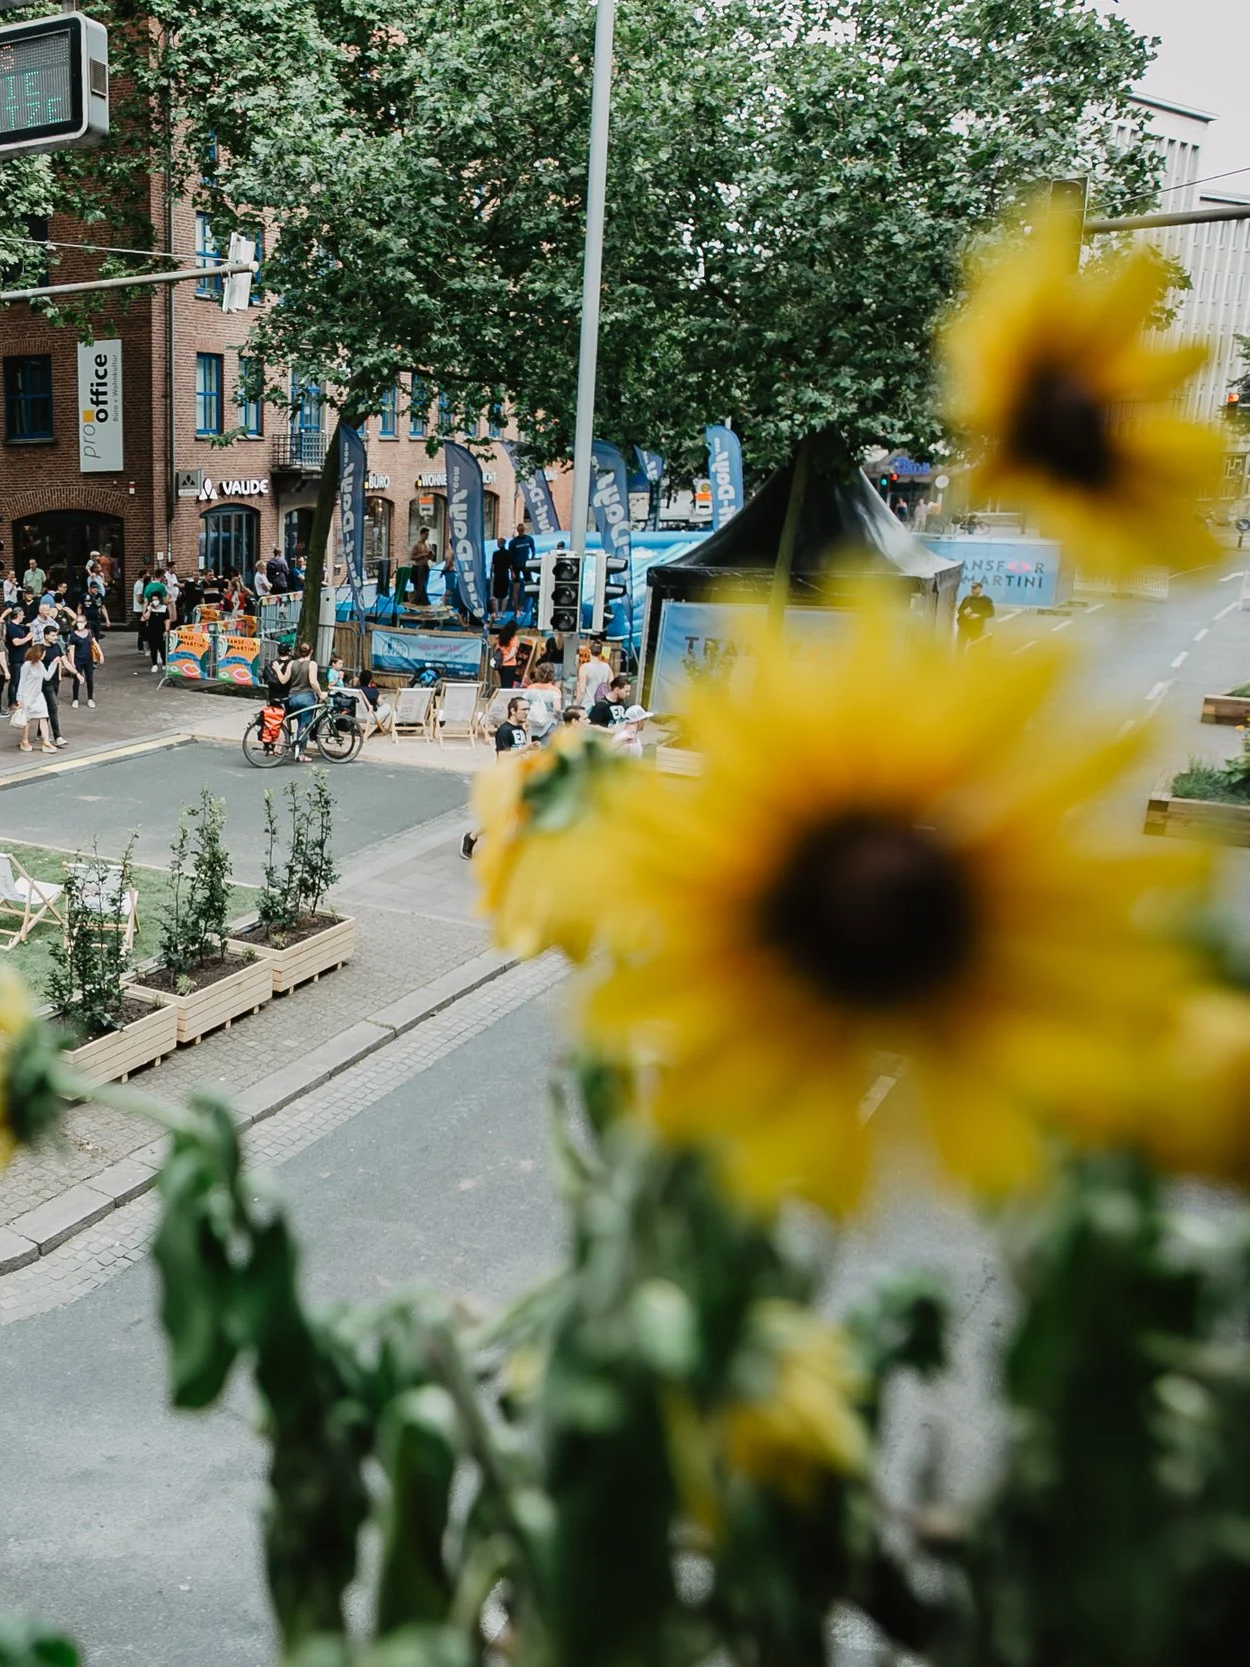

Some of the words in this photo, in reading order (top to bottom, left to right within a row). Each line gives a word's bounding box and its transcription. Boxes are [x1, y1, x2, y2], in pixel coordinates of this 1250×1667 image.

[90, 354, 108, 423] office
[83, 424, 101, 459] pro
[222, 479, 269, 495] VAUDE
[961, 574, 1043, 588] MARTINI
